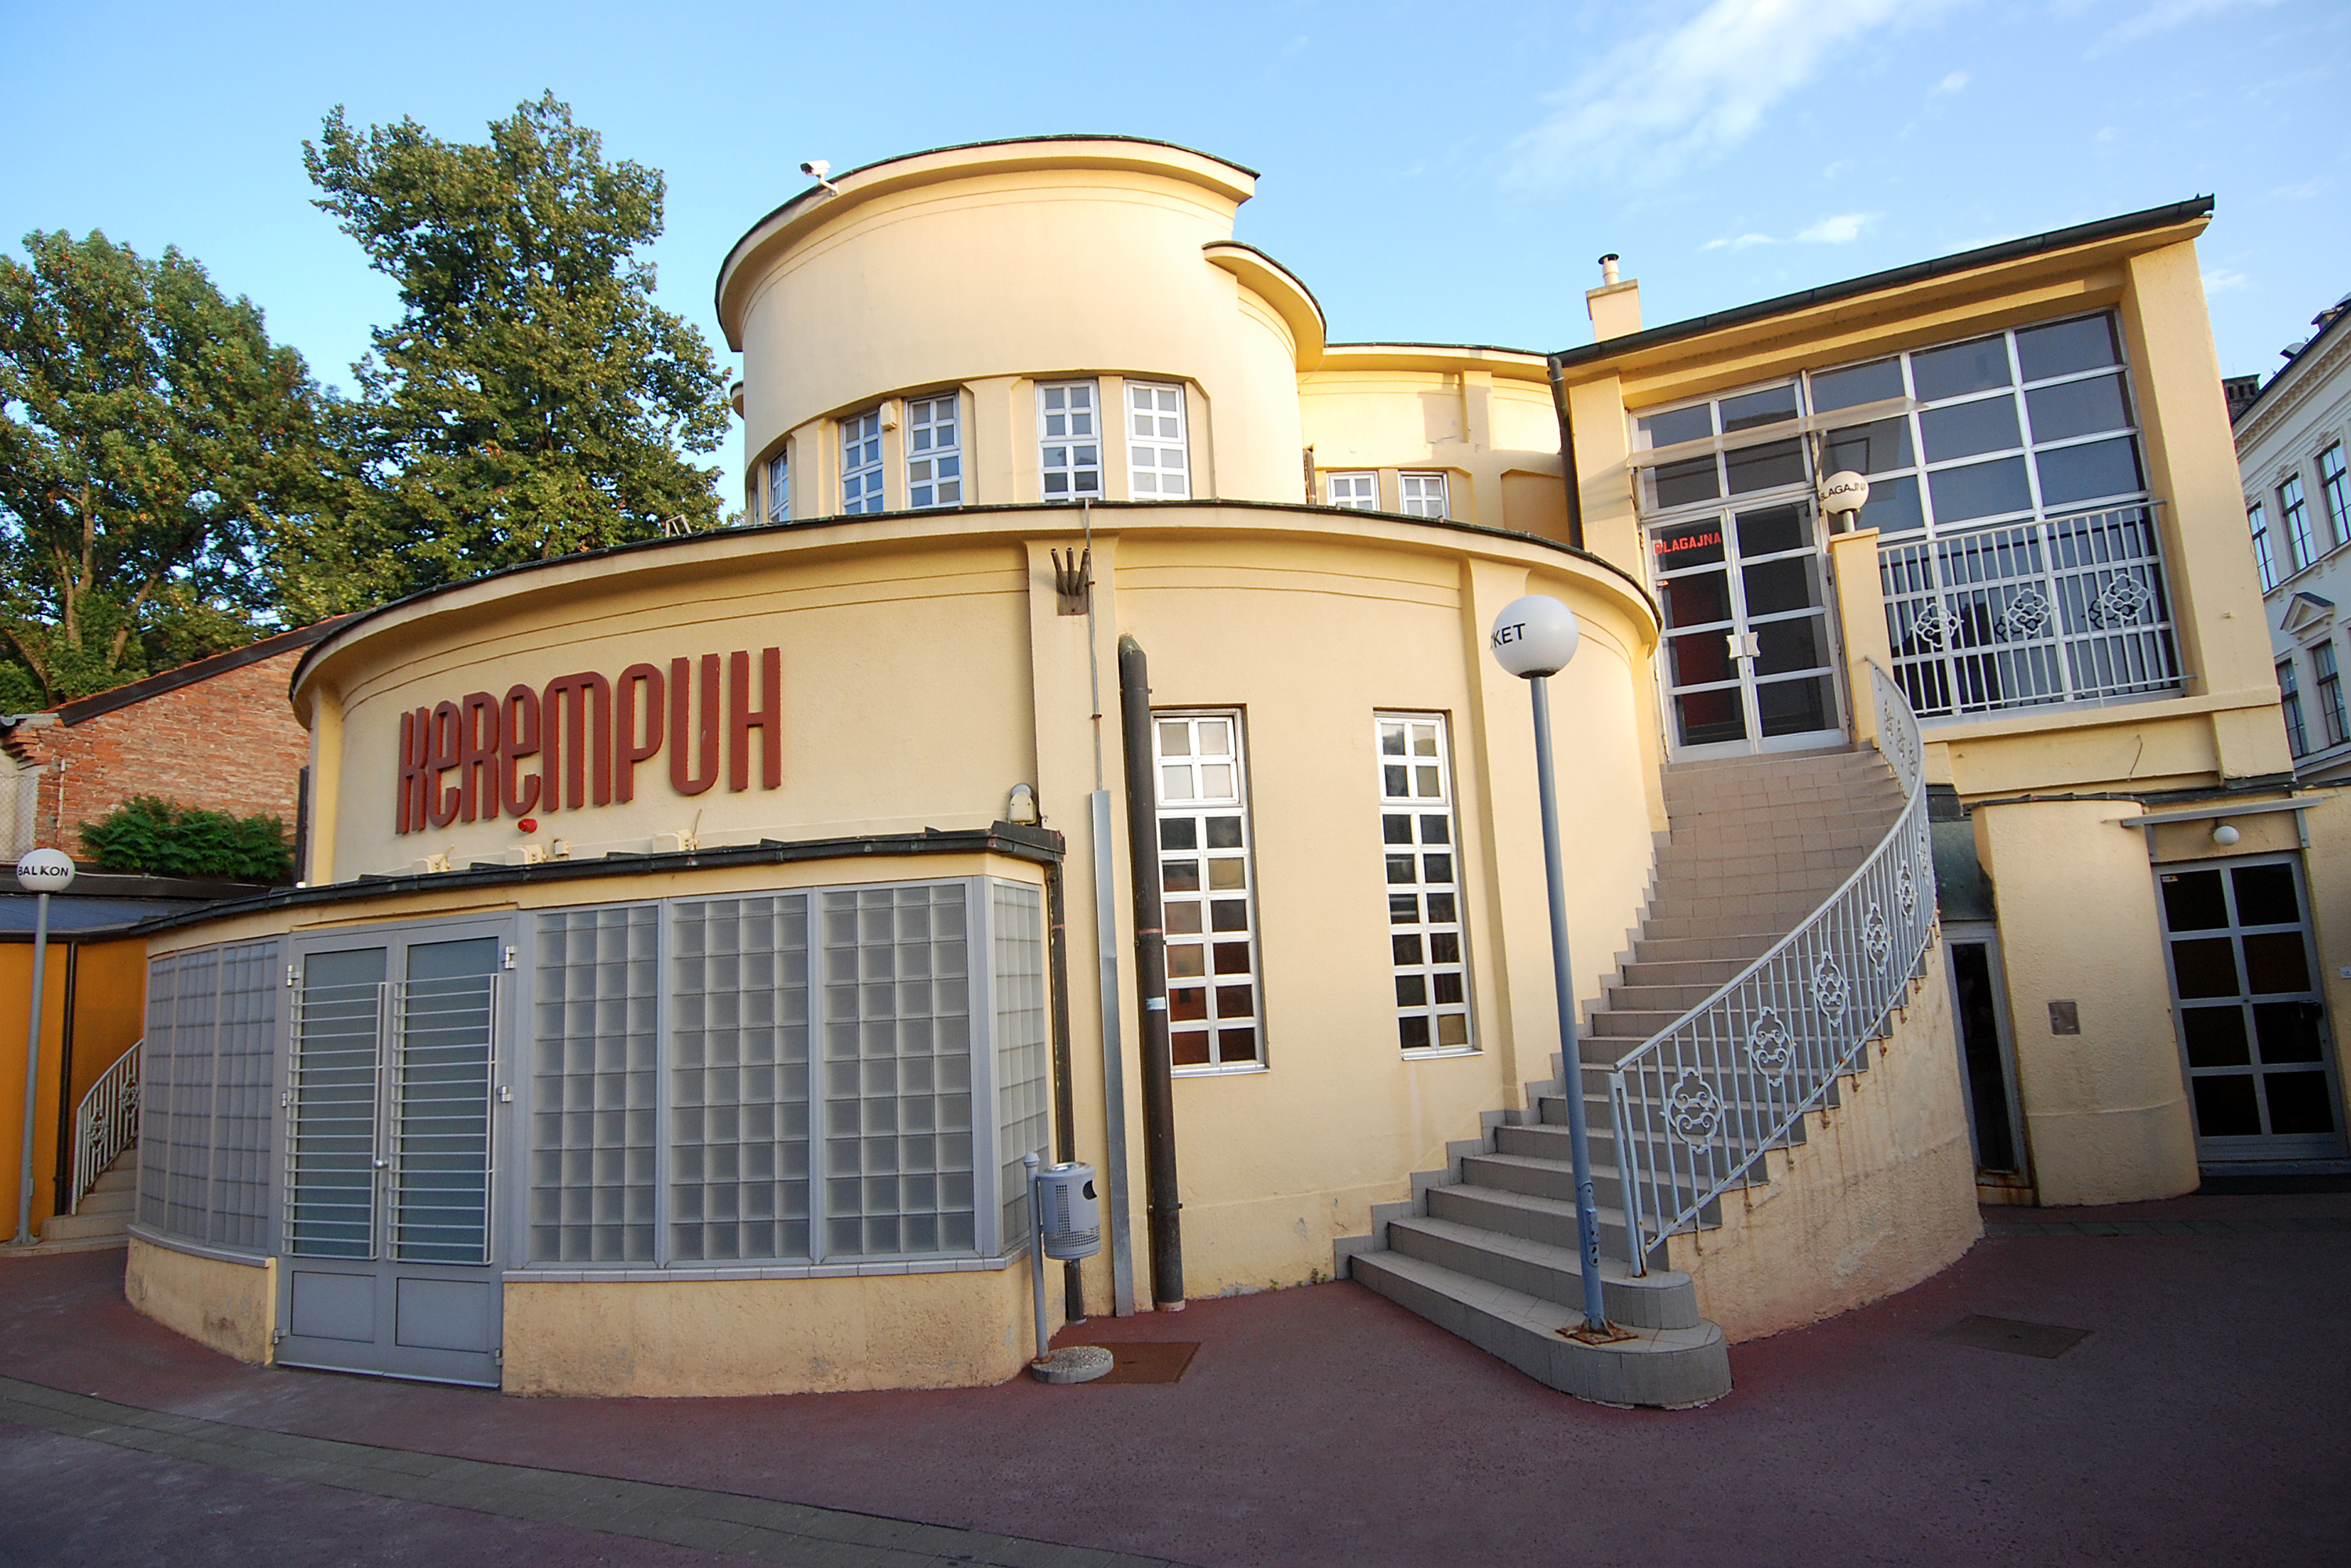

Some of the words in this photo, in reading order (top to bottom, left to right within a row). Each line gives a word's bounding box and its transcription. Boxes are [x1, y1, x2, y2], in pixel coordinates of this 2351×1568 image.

[1654, 532, 1722, 555] BLAGAJNA
[1489, 622, 1526, 650] KET
[18, 866, 69, 877] BALKON
